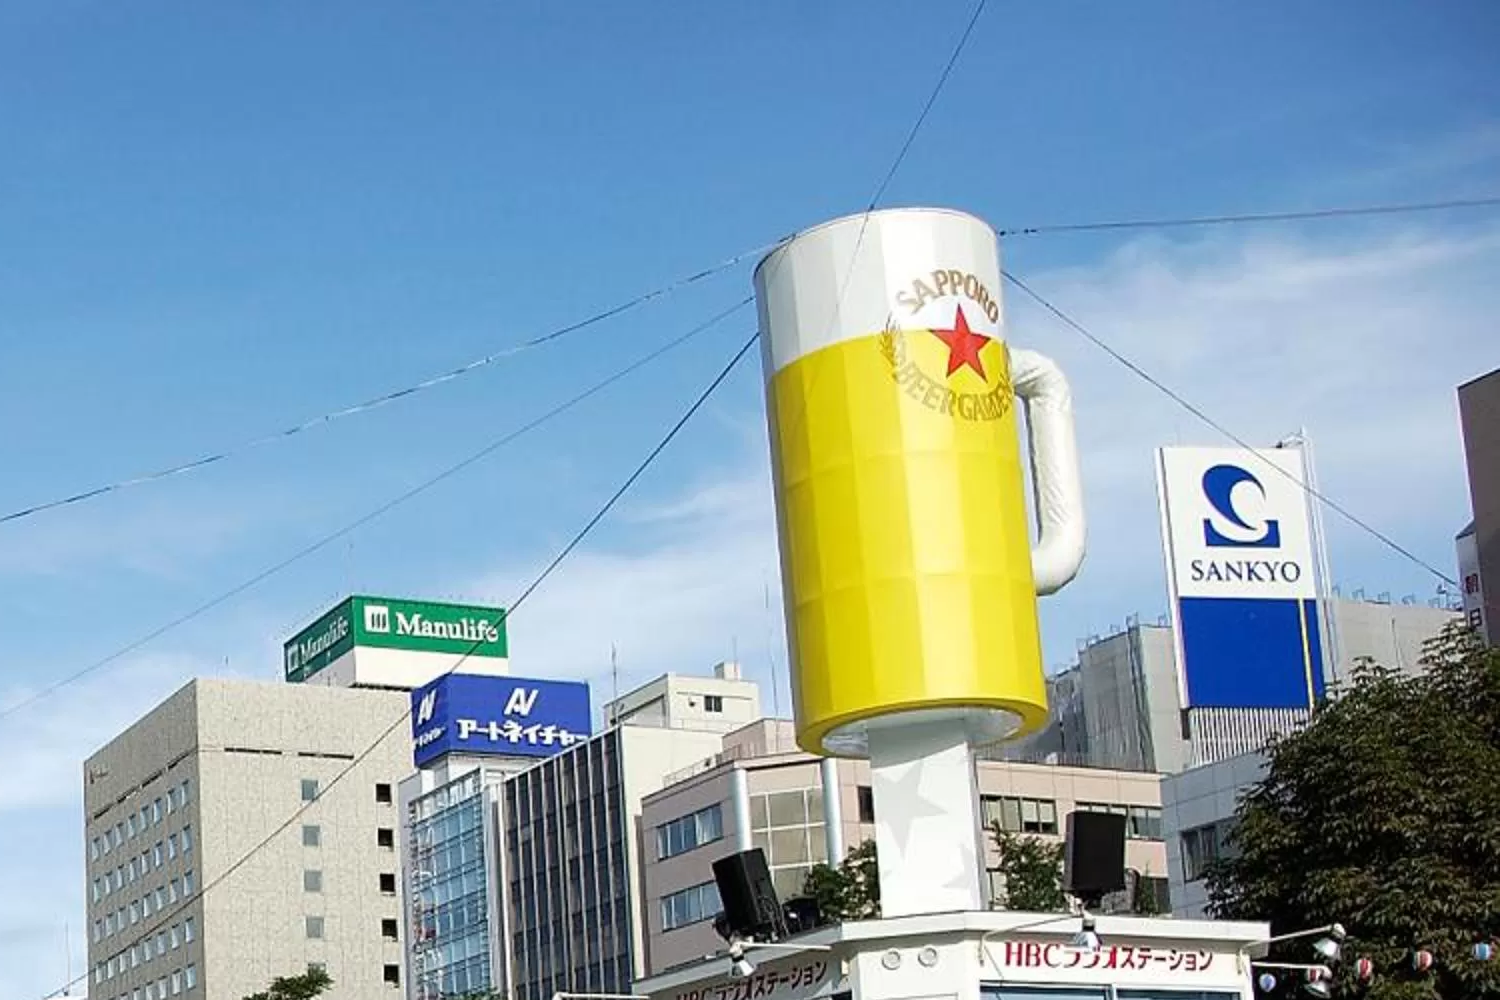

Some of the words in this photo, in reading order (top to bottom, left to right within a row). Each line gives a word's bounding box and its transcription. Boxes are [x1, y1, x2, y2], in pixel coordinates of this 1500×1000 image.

[896, 269, 999, 324] SAPPORO
[895, 362, 956, 417] BEER
[1191, 560, 1300, 583] SANKYO
[396, 611, 499, 642] Manulife
[456, 719, 588, 746] アートネイチャー
[1005, 942, 1213, 972] HBCラジオステーション
